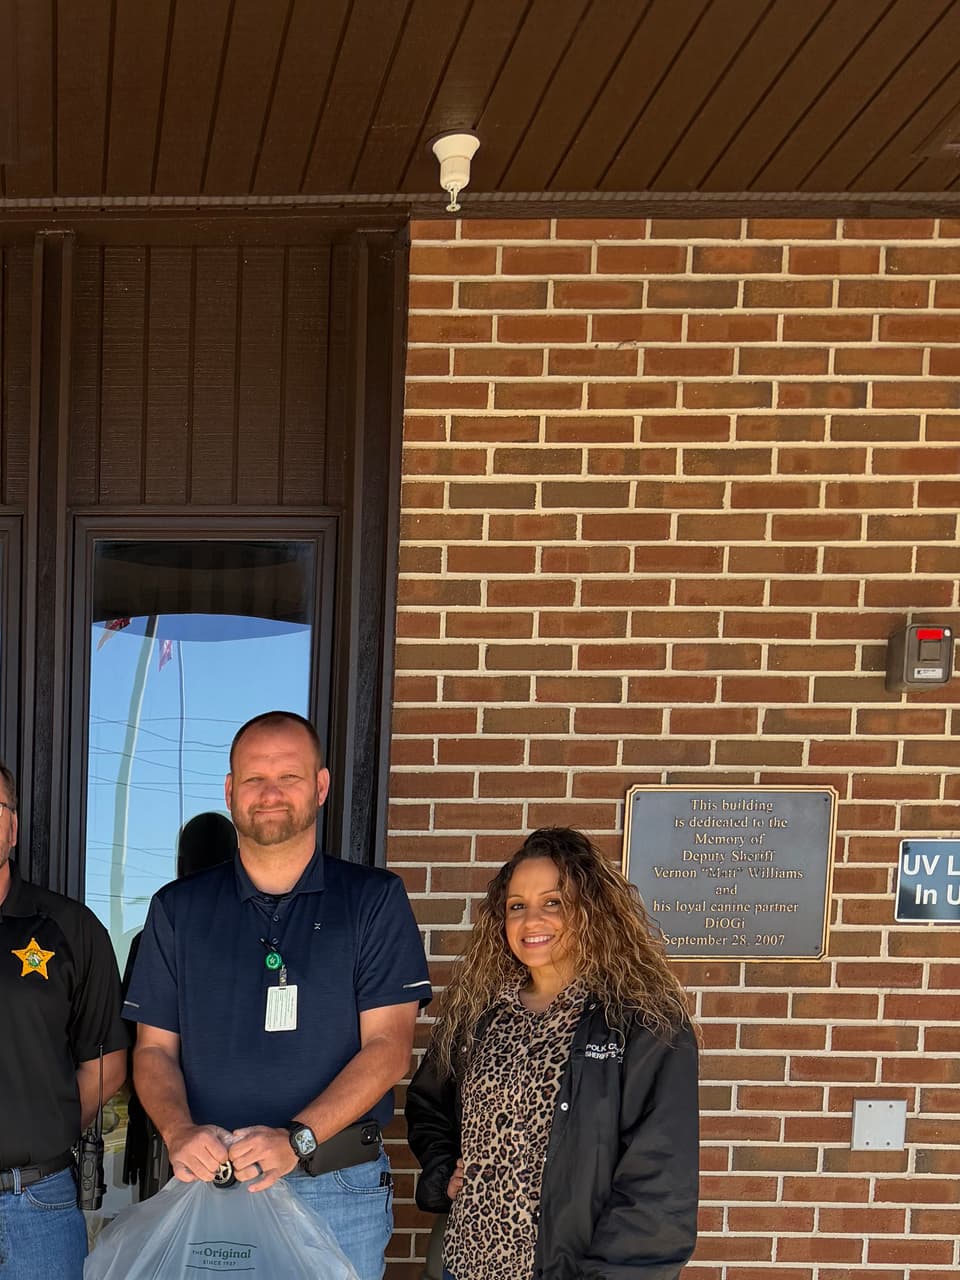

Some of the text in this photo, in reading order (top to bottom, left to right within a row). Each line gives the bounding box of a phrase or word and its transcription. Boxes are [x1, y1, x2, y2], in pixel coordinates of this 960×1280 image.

[690, 799, 774, 813] This building
[674, 816, 789, 829] is dedicated to the
[695, 833, 766, 847] Memory of
[682, 850, 776, 864] Deputy Sheriff
[903, 854, 941, 876] UV
[653, 866, 698, 879] Vernon
[748, 866, 804, 880] Williams
[714, 884, 738, 896] and
[915, 884, 938, 905] In
[652, 900, 799, 916] his loyal canine partner
[662, 934, 728, 948] September
[755, 934, 786, 946] 2007
[585, 1043, 607, 1052] POLK
[203, 1247, 252, 1260] Original
